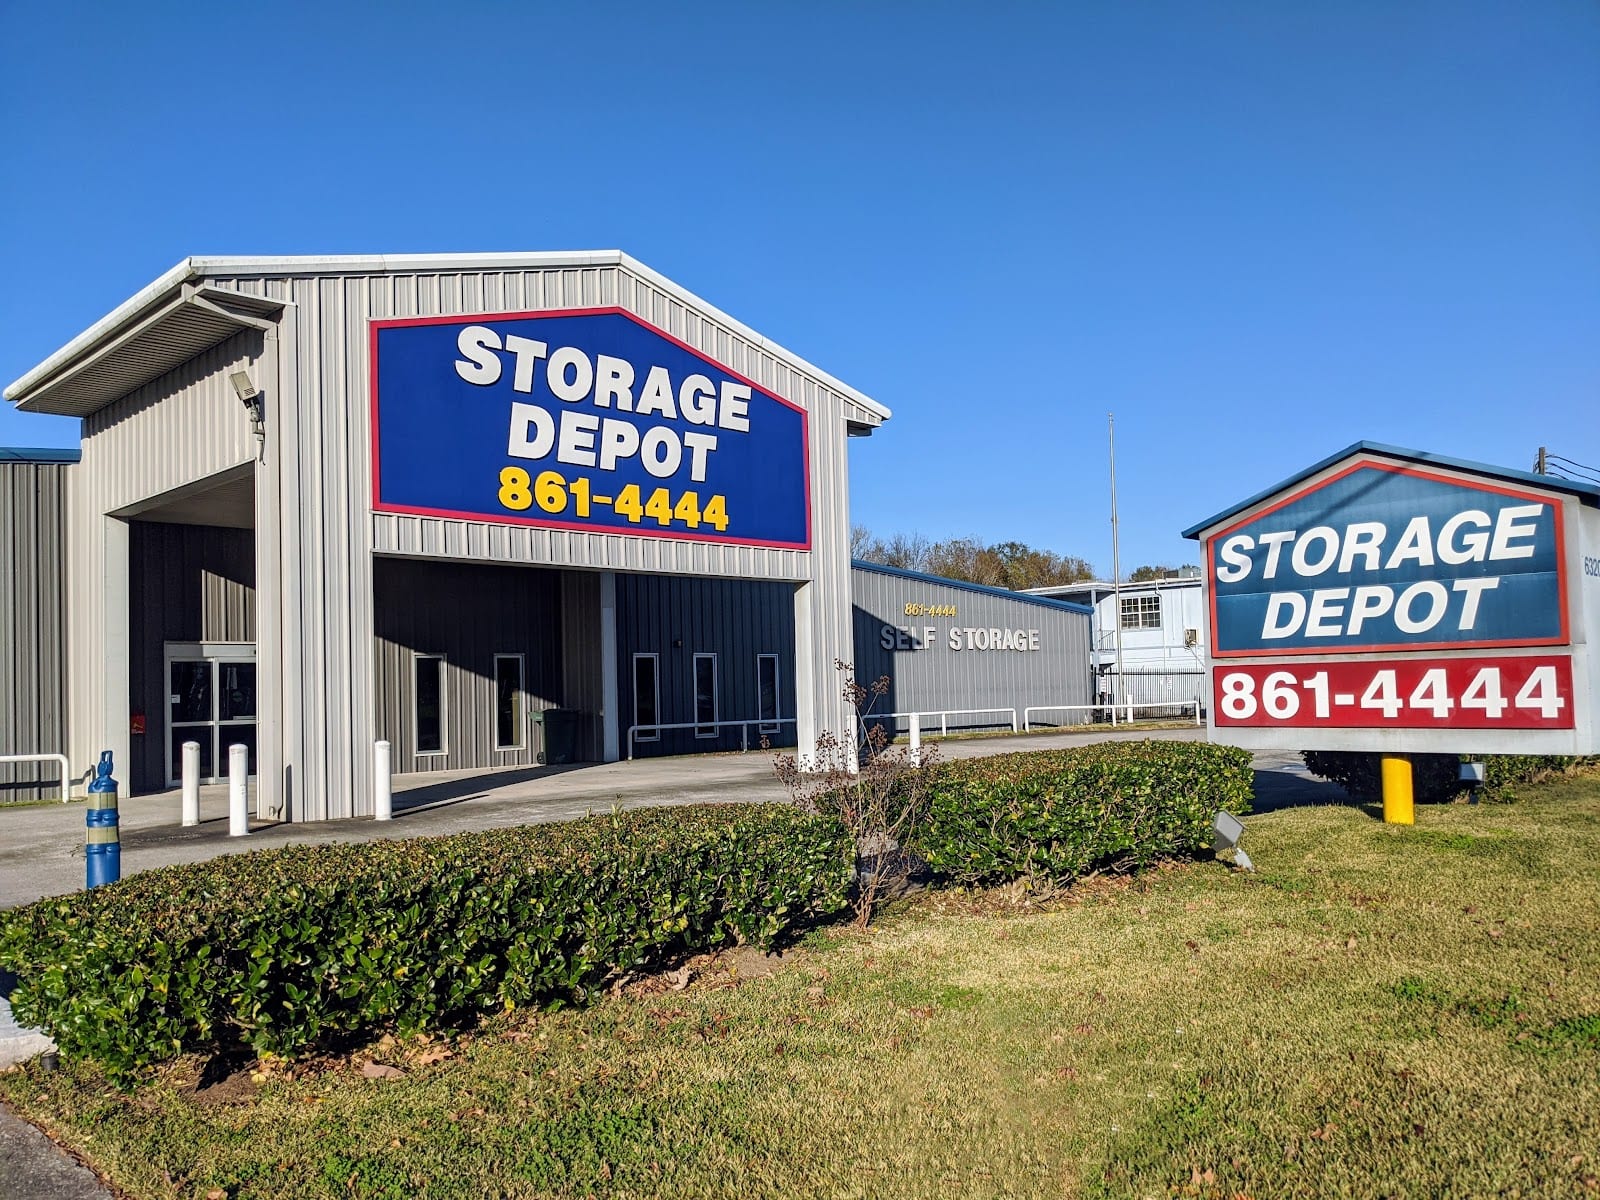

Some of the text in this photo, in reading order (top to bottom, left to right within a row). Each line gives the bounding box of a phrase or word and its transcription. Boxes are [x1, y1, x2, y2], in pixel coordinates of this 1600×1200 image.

[455, 326, 752, 432] STORAGE
[507, 402, 718, 482] DEPOT
[498, 466, 729, 531] 861-4444
[1216, 503, 1544, 583] STORAGE
[880, 625, 1040, 651] SELF STORAGE
[904, 602, 957, 617] 861-4444
[1261, 577, 1500, 640] DEPOT
[1220, 665, 1565, 720] 861-4444
